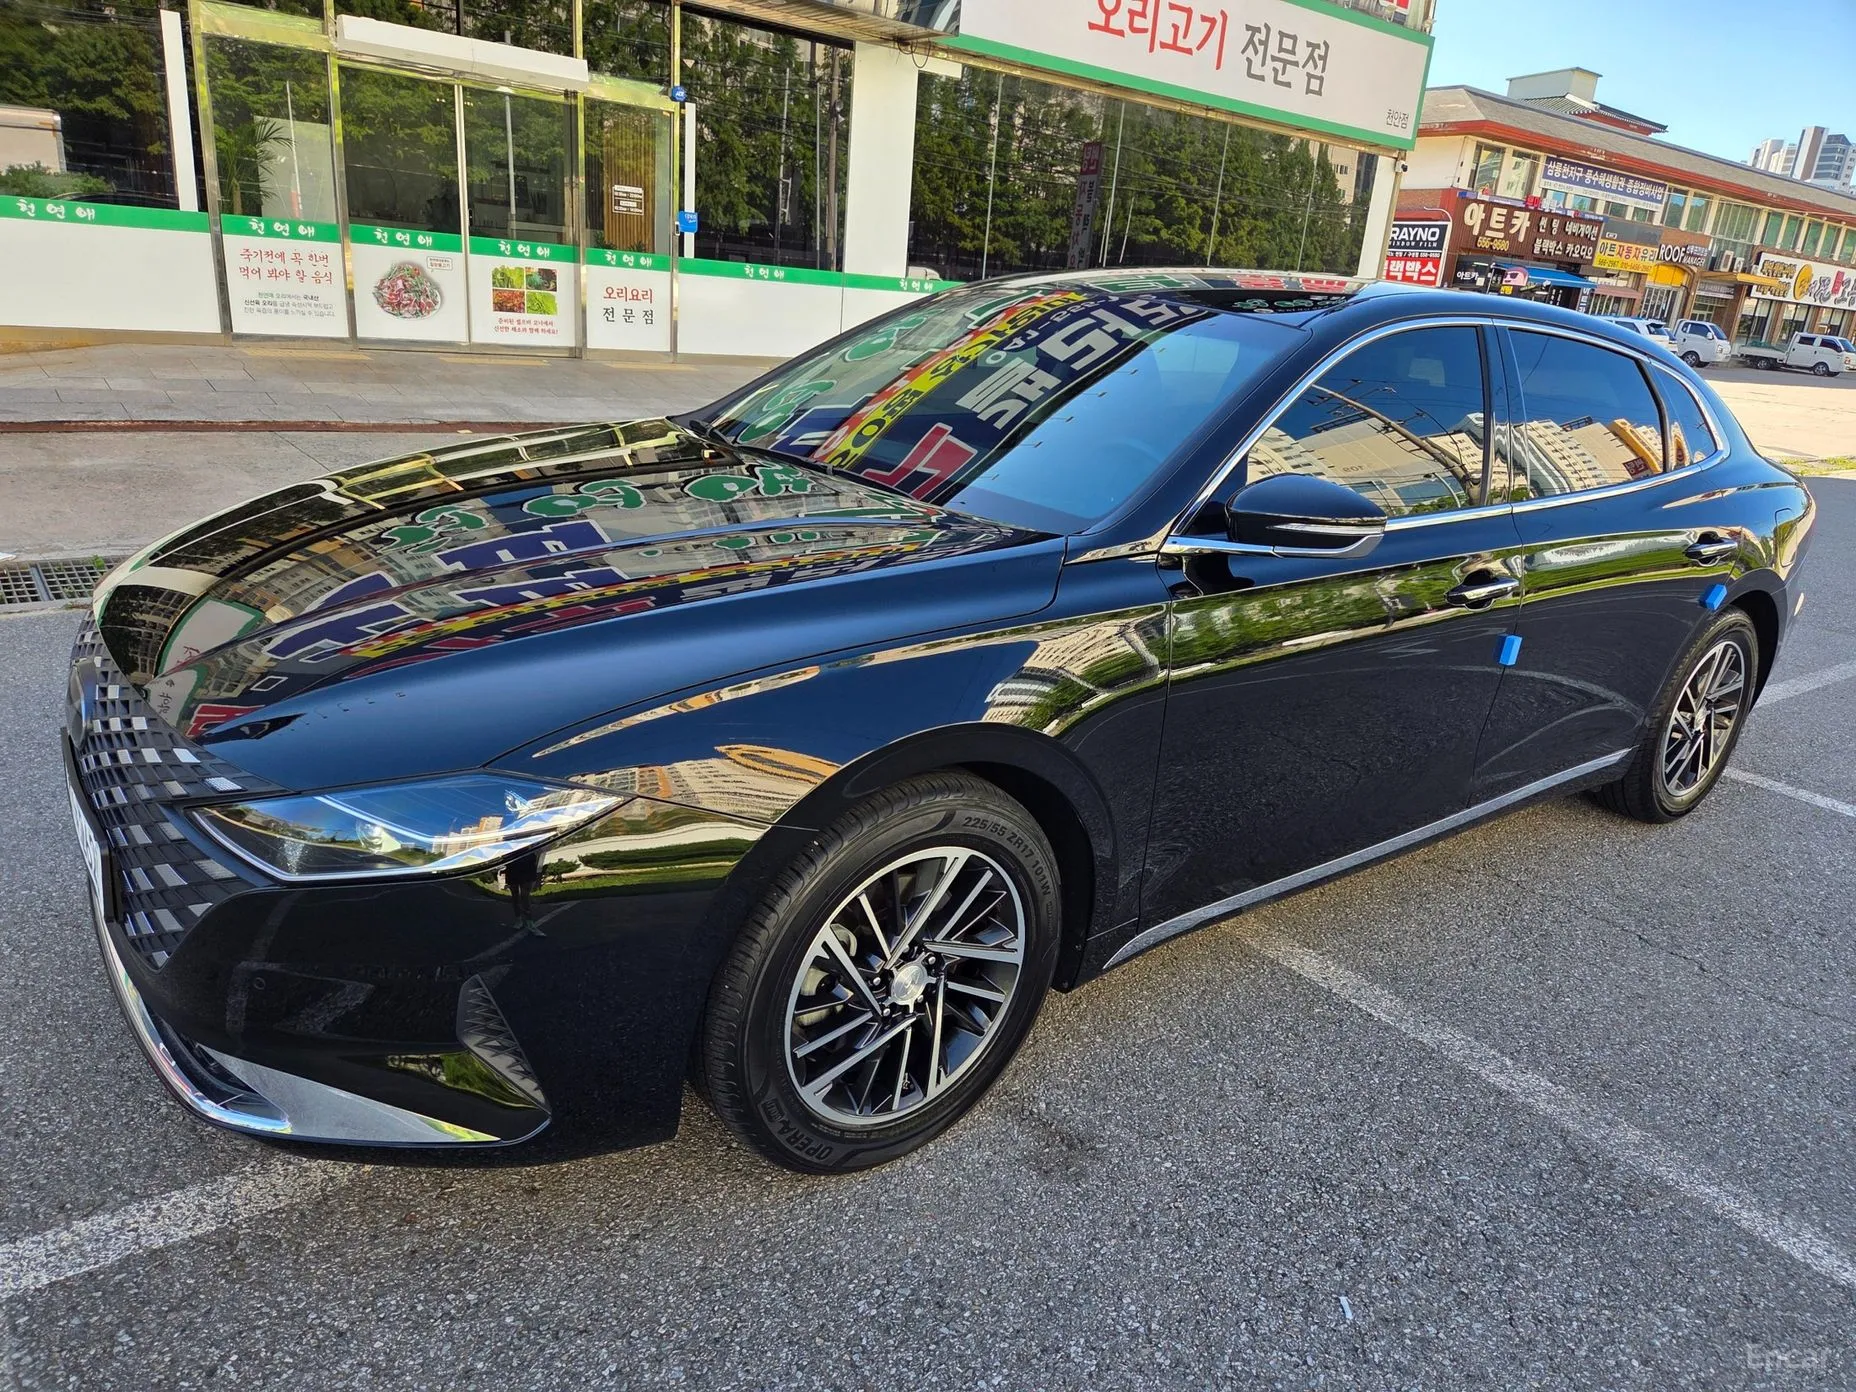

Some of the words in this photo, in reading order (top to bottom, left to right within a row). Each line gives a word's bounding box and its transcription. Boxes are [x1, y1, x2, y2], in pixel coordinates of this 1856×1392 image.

[1087, 0, 1229, 71] 오리고기
[1240, 22, 1331, 97] 전문점
[1386, 108, 1410, 130] 천안점
[1463, 202, 1531, 242] 아트카
[1565, 220, 1599, 241] 네비게이션
[1390, 227, 1440, 241] RAYNO
[240, 249, 285, 264] 죽기전에
[291, 251, 303, 266] 꼭
[308, 250, 329, 267] 한번
[1533, 238, 1563, 256] 블랙박스
[1565, 243, 1593, 259] 카오디오
[1600, 241, 1658, 263] 아트자동차유리
[1659, 244, 1686, 263] ROOF
[239, 265, 261, 280] 먹어
[267, 267, 290, 281] 봐야
[295, 269, 307, 283] 할
[312, 271, 332, 284] 음식
[603, 286, 653, 304] 오리요리
[602, 307, 654, 325] 전문점
[962, 816, 1008, 837] 225/55
[1006, 831, 1035, 859] ZR17
[1031, 860, 1051, 897] 101W
